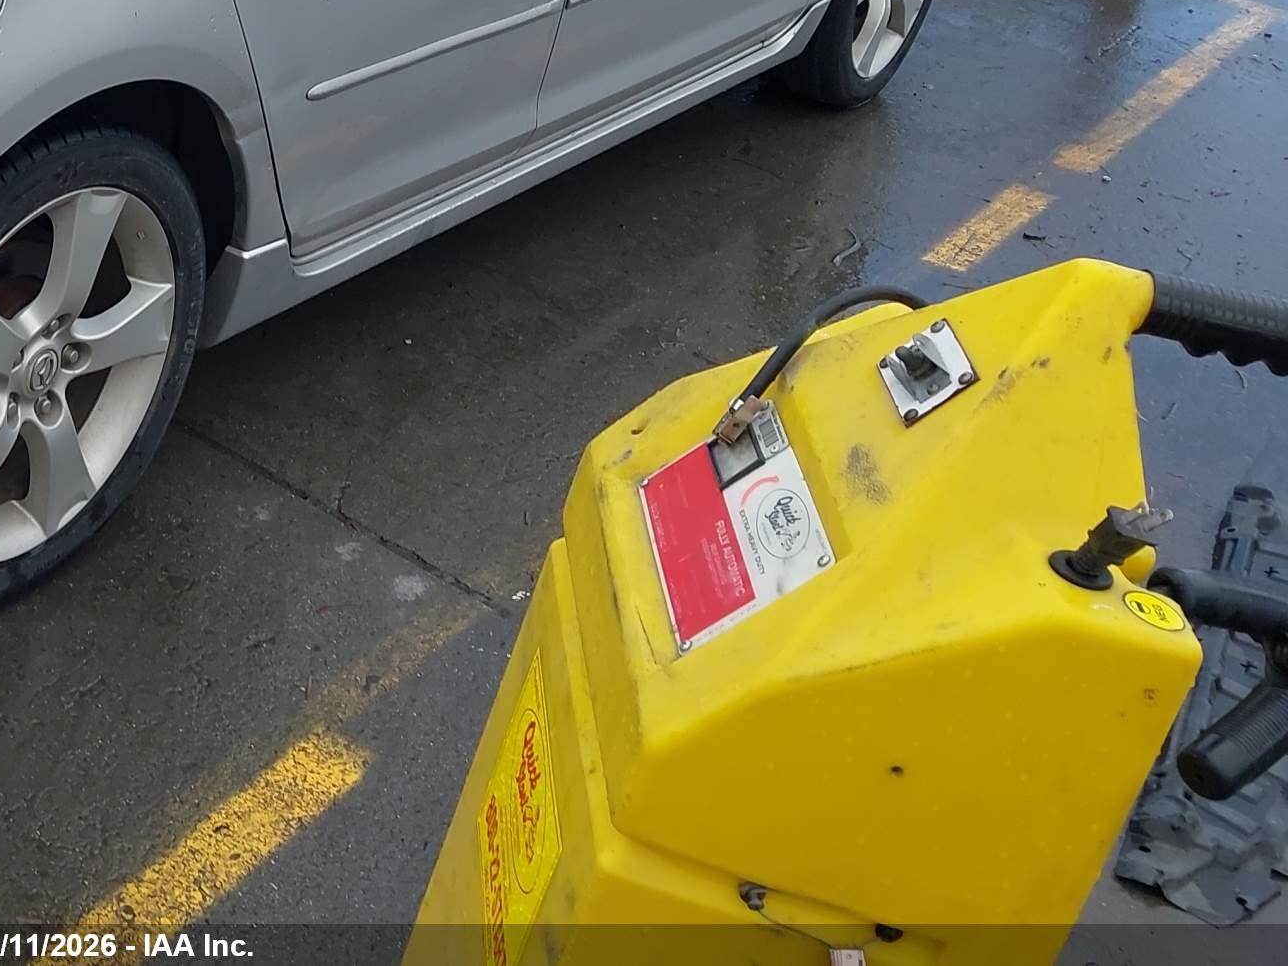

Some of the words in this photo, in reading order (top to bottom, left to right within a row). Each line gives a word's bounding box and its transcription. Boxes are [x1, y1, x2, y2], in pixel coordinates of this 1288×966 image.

[739, 509, 751, 532] EXTRA
[748, 532, 759, 555] HEAVY
[754, 555, 766, 575] DUTY
[774, 496, 802, 527] Quick
[714, 519, 730, 546] FULLY
[723, 545, 746, 597] AUTOMATIC
